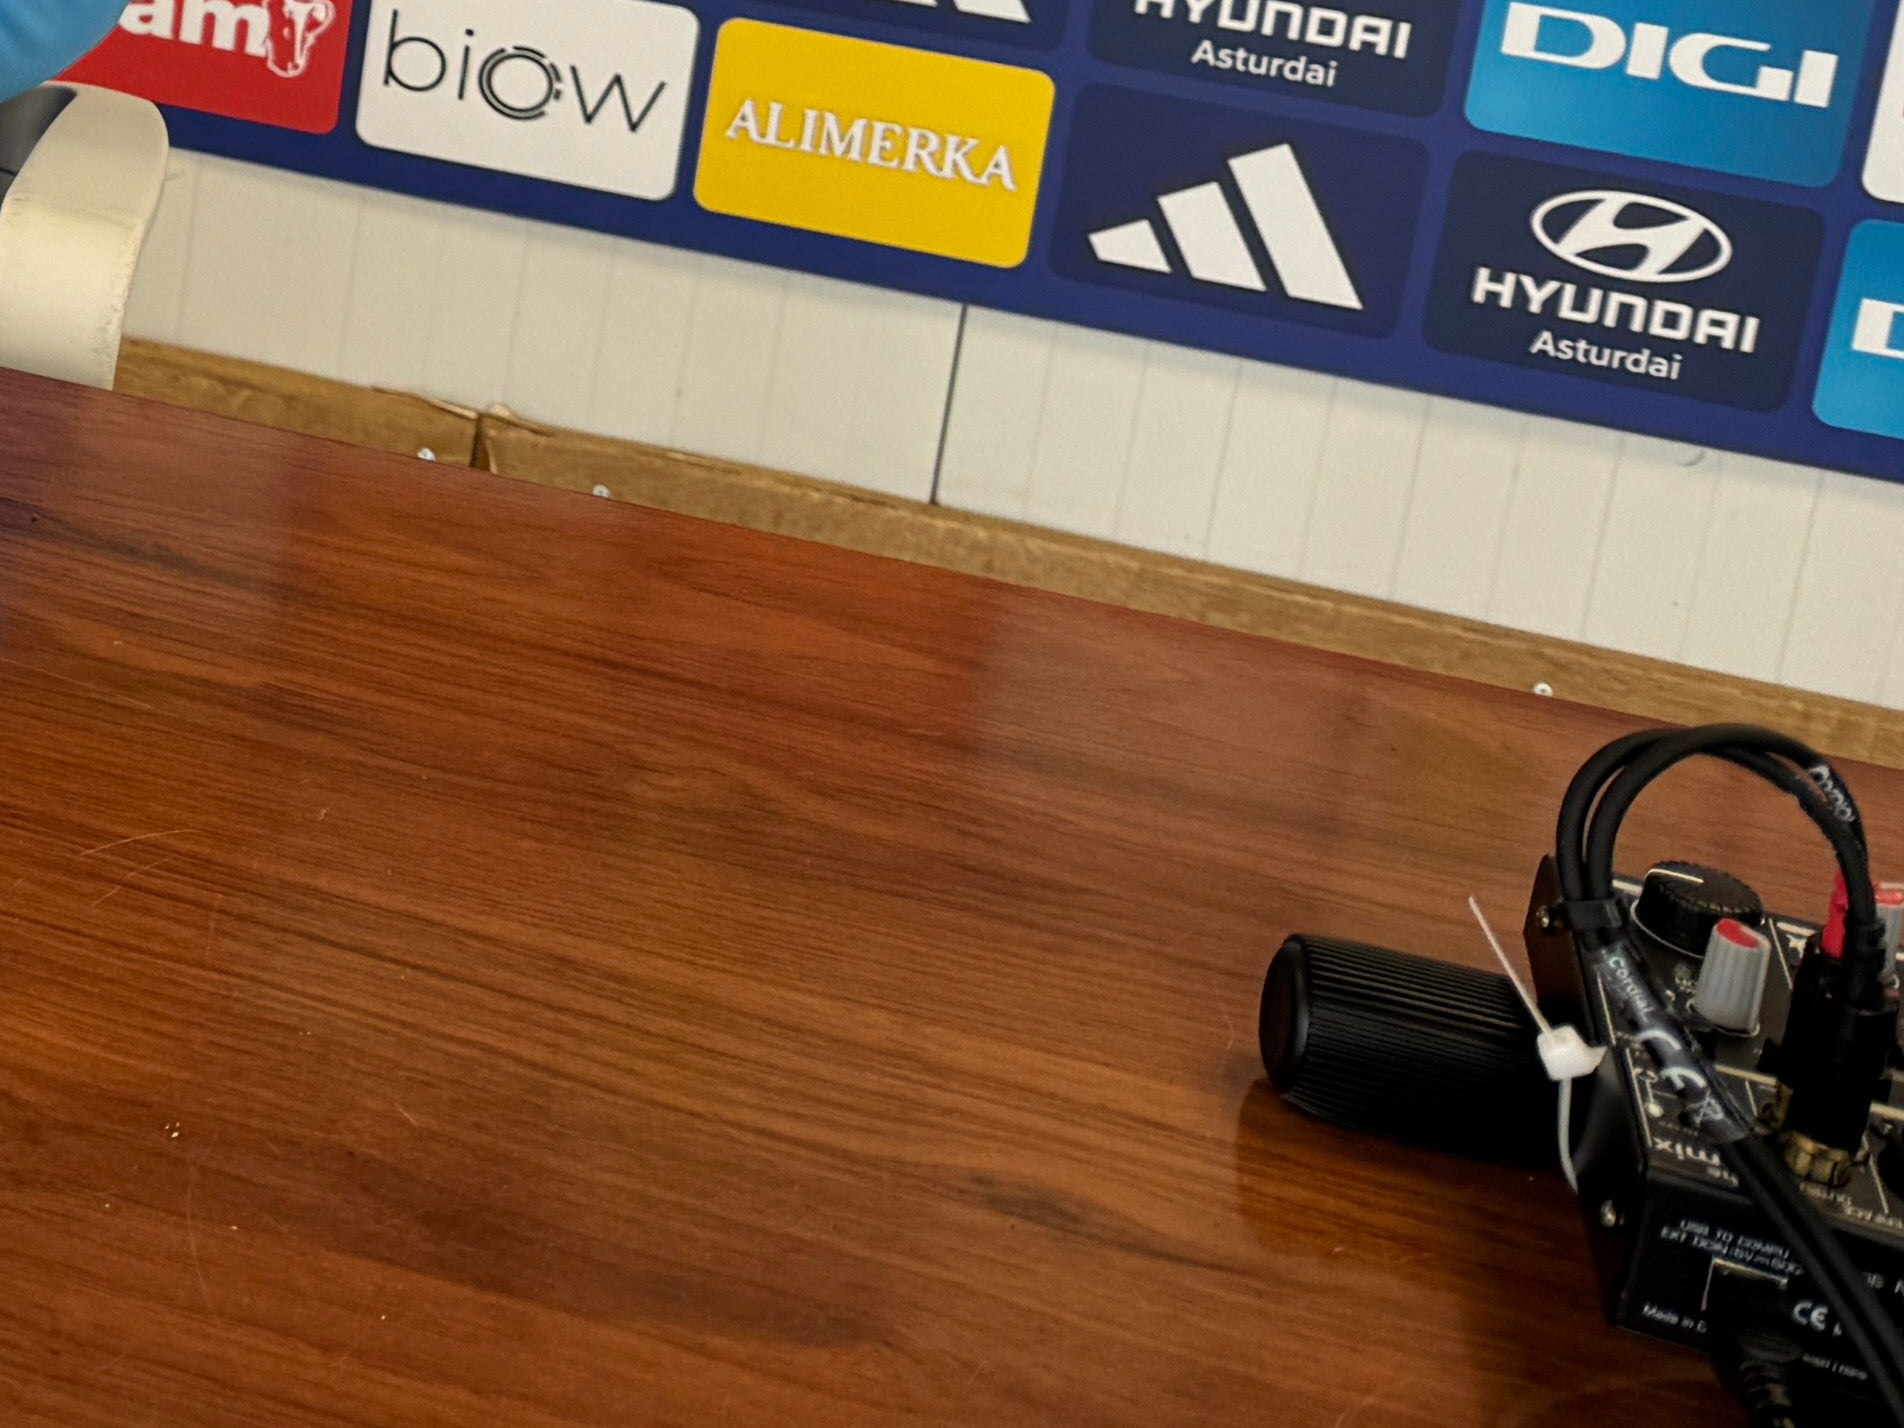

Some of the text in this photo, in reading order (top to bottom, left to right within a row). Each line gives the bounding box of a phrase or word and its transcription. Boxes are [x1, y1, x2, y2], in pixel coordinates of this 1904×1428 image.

[1191, 40, 1337, 88] Asturdai
[1500, 2, 1837, 108] DIGI
[725, 98, 1015, 191] ALIMERKA
[1472, 267, 1760, 353] HYUNDAI
[1529, 333, 1681, 379] Asturdai
